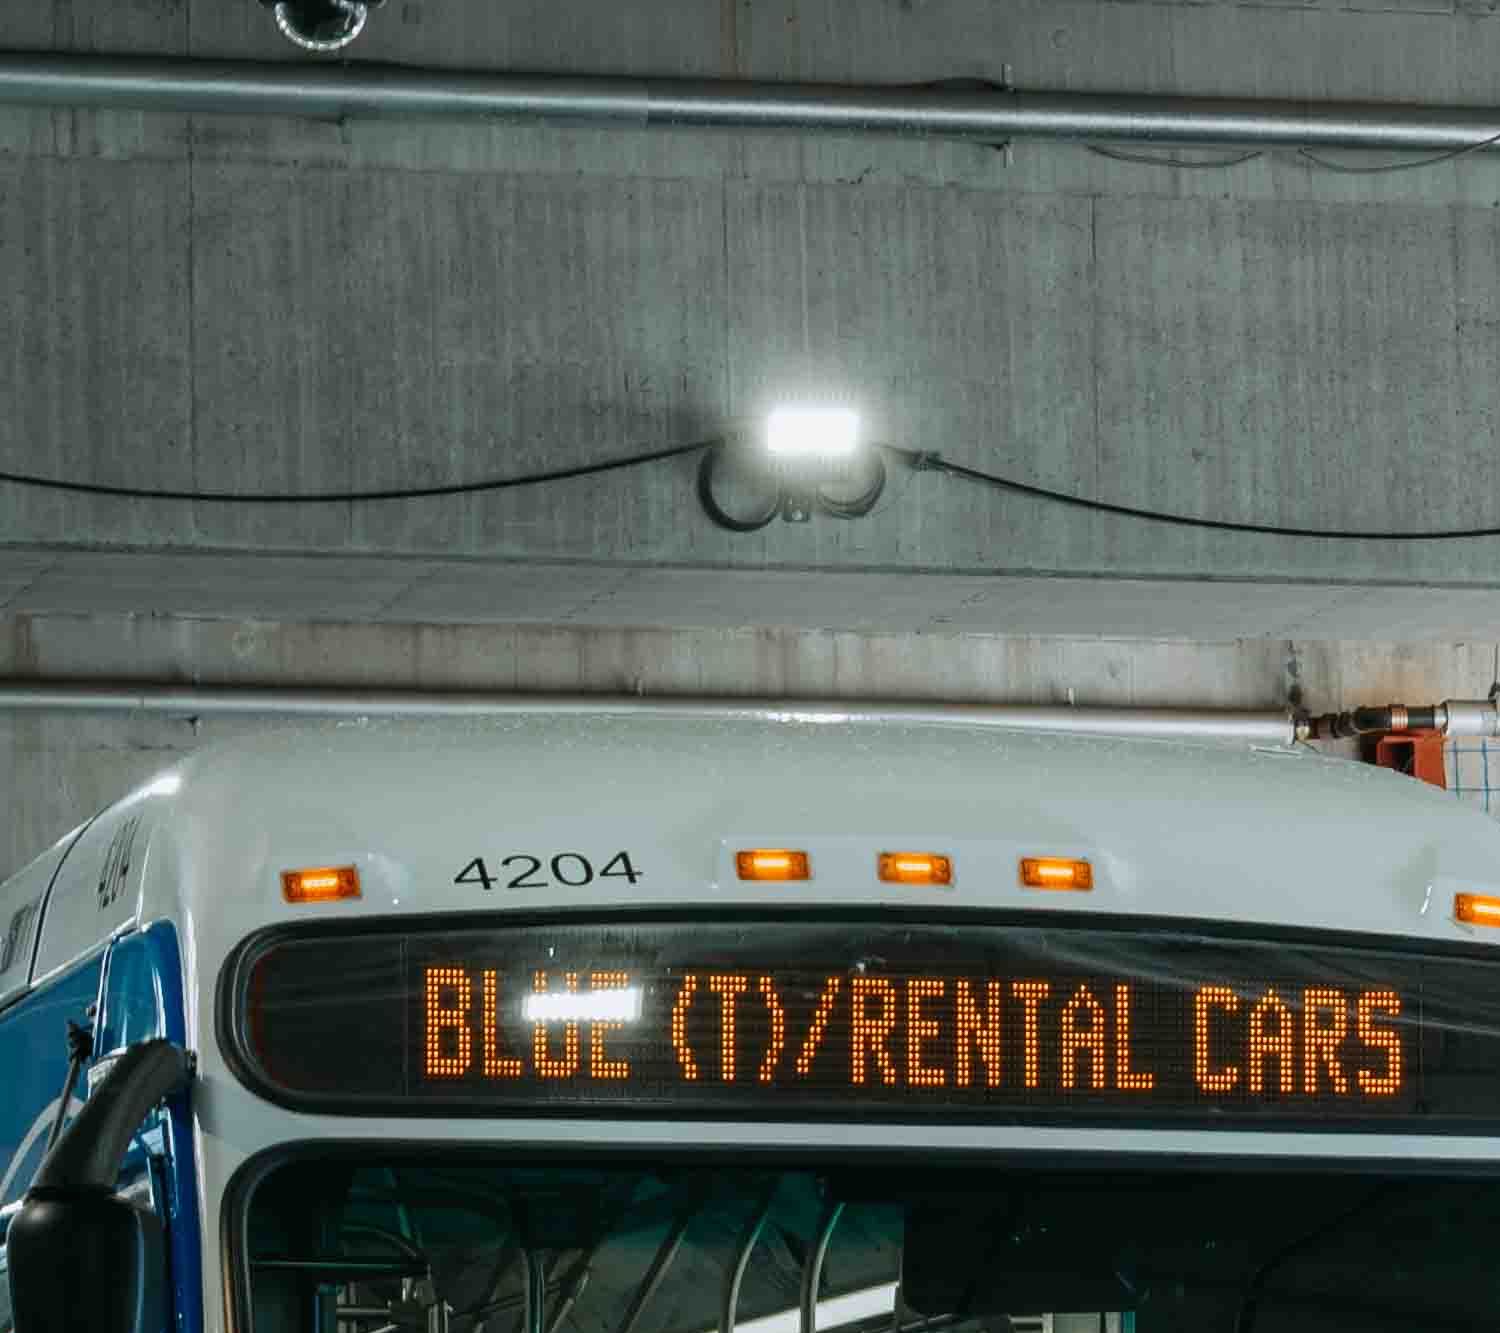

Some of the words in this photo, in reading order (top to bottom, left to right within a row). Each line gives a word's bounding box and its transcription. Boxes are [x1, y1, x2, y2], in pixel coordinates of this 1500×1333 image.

[454, 850, 643, 891] 4204
[424, 966, 630, 1081] BLUE
[672, 972, 1155, 1090] (T)/RENTAL
[1194, 984, 1402, 1096] CARS
